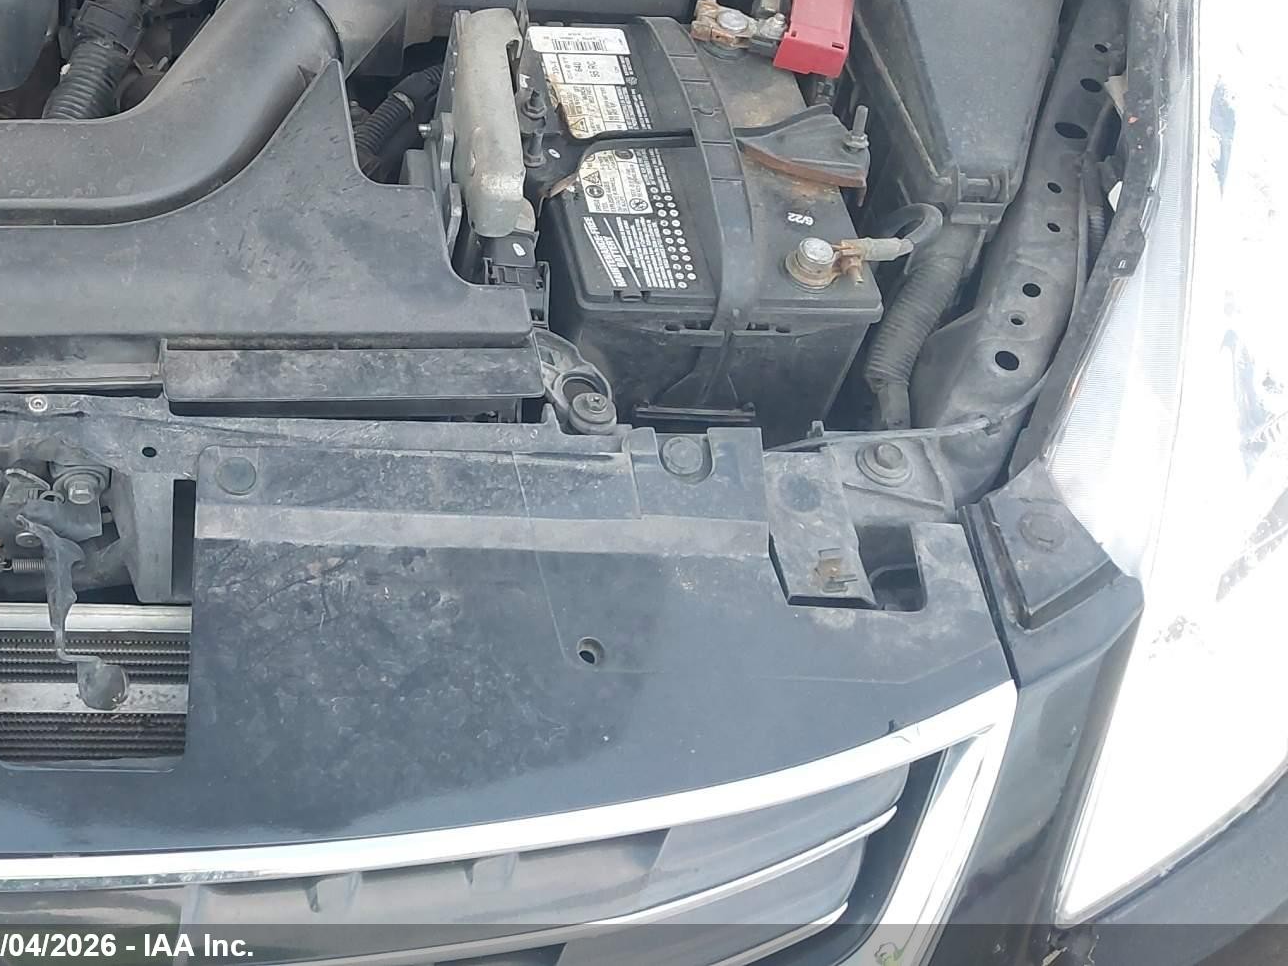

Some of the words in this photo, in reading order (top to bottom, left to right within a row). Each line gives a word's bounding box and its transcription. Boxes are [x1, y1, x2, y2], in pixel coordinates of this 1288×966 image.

[787, 212, 814, 225] 6/22
[583, 216, 628, 287] MAINTENANCE-FREE
[602, 235, 627, 268] BATTERY
